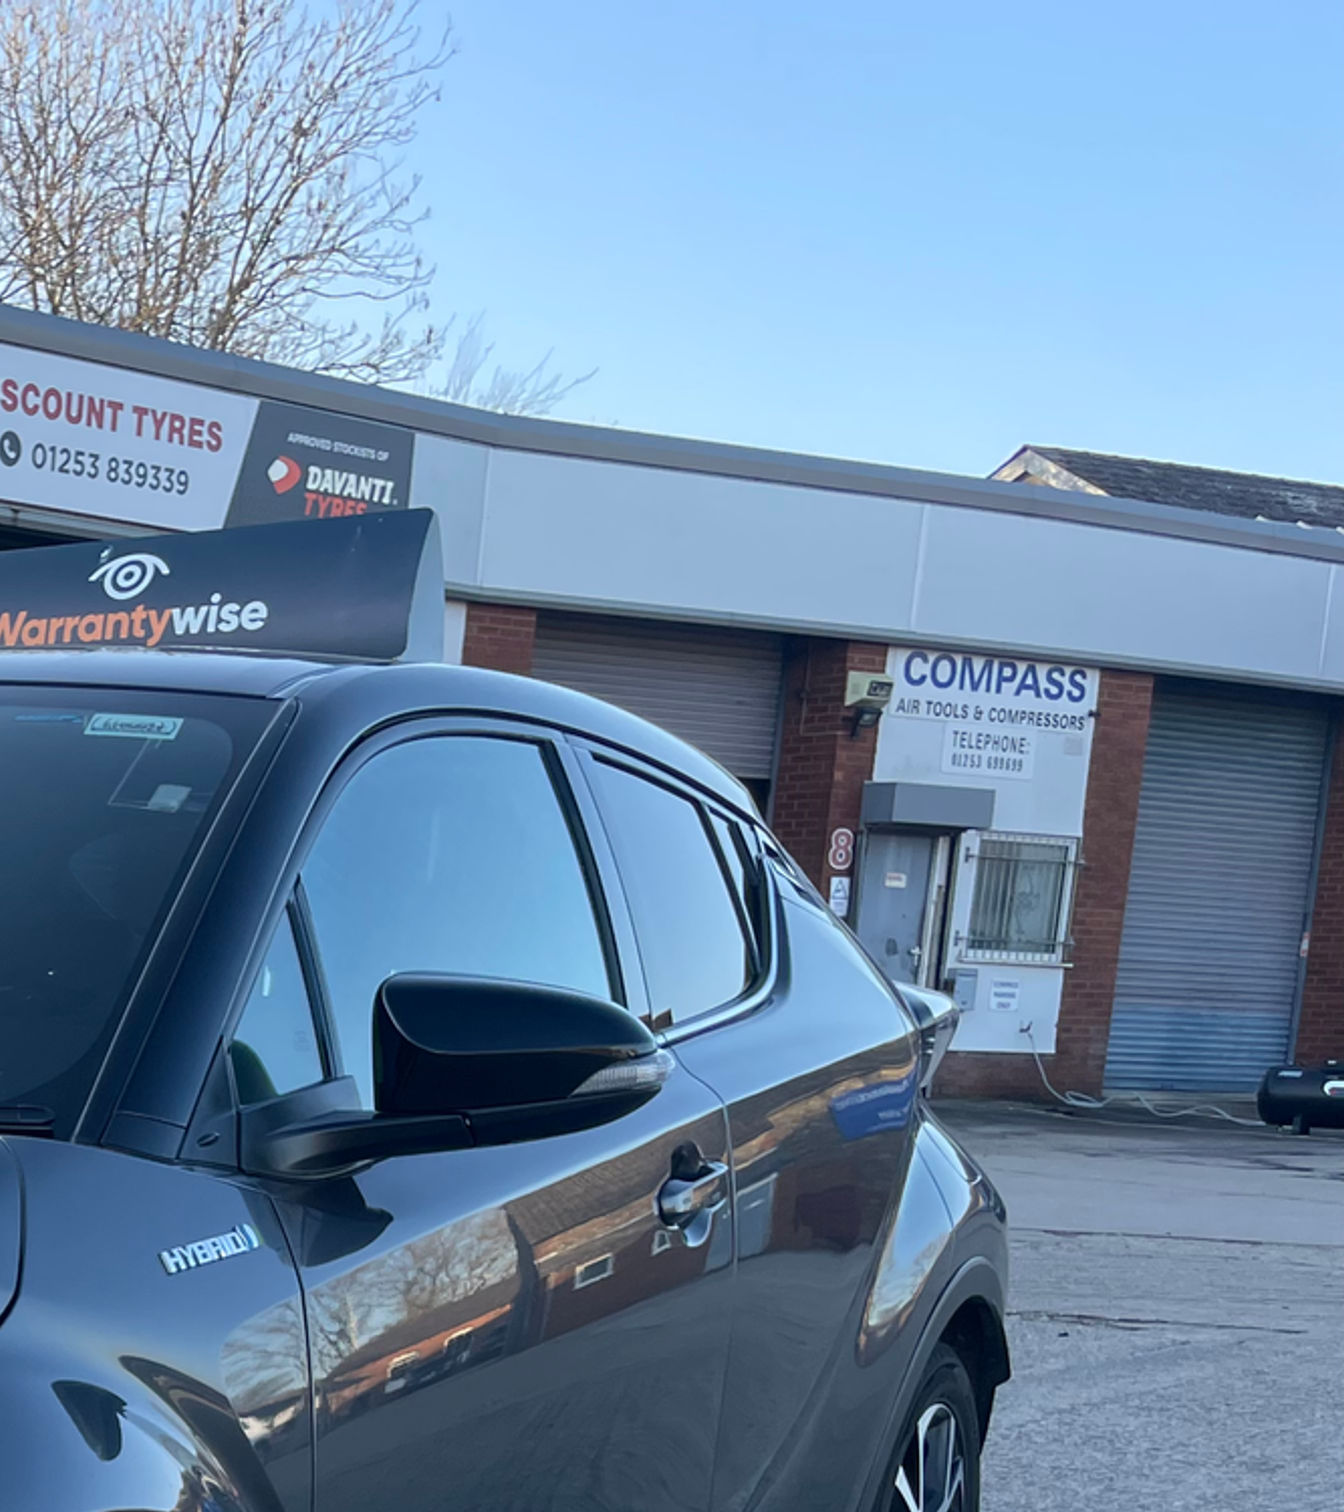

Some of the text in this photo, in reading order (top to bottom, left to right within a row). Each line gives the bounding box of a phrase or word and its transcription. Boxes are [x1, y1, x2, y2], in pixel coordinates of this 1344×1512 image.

[132, 405, 223, 453] TYRES
[31, 442, 190, 496] 01253 839339
[376, 451, 390, 462] OF
[903, 651, 1088, 703] COMPASS
[895, 698, 1086, 731] AIR TOOLS & COMPRESSORS
[828, 828, 854, 870] 8
[160, 1231, 249, 1274] HYBRID
